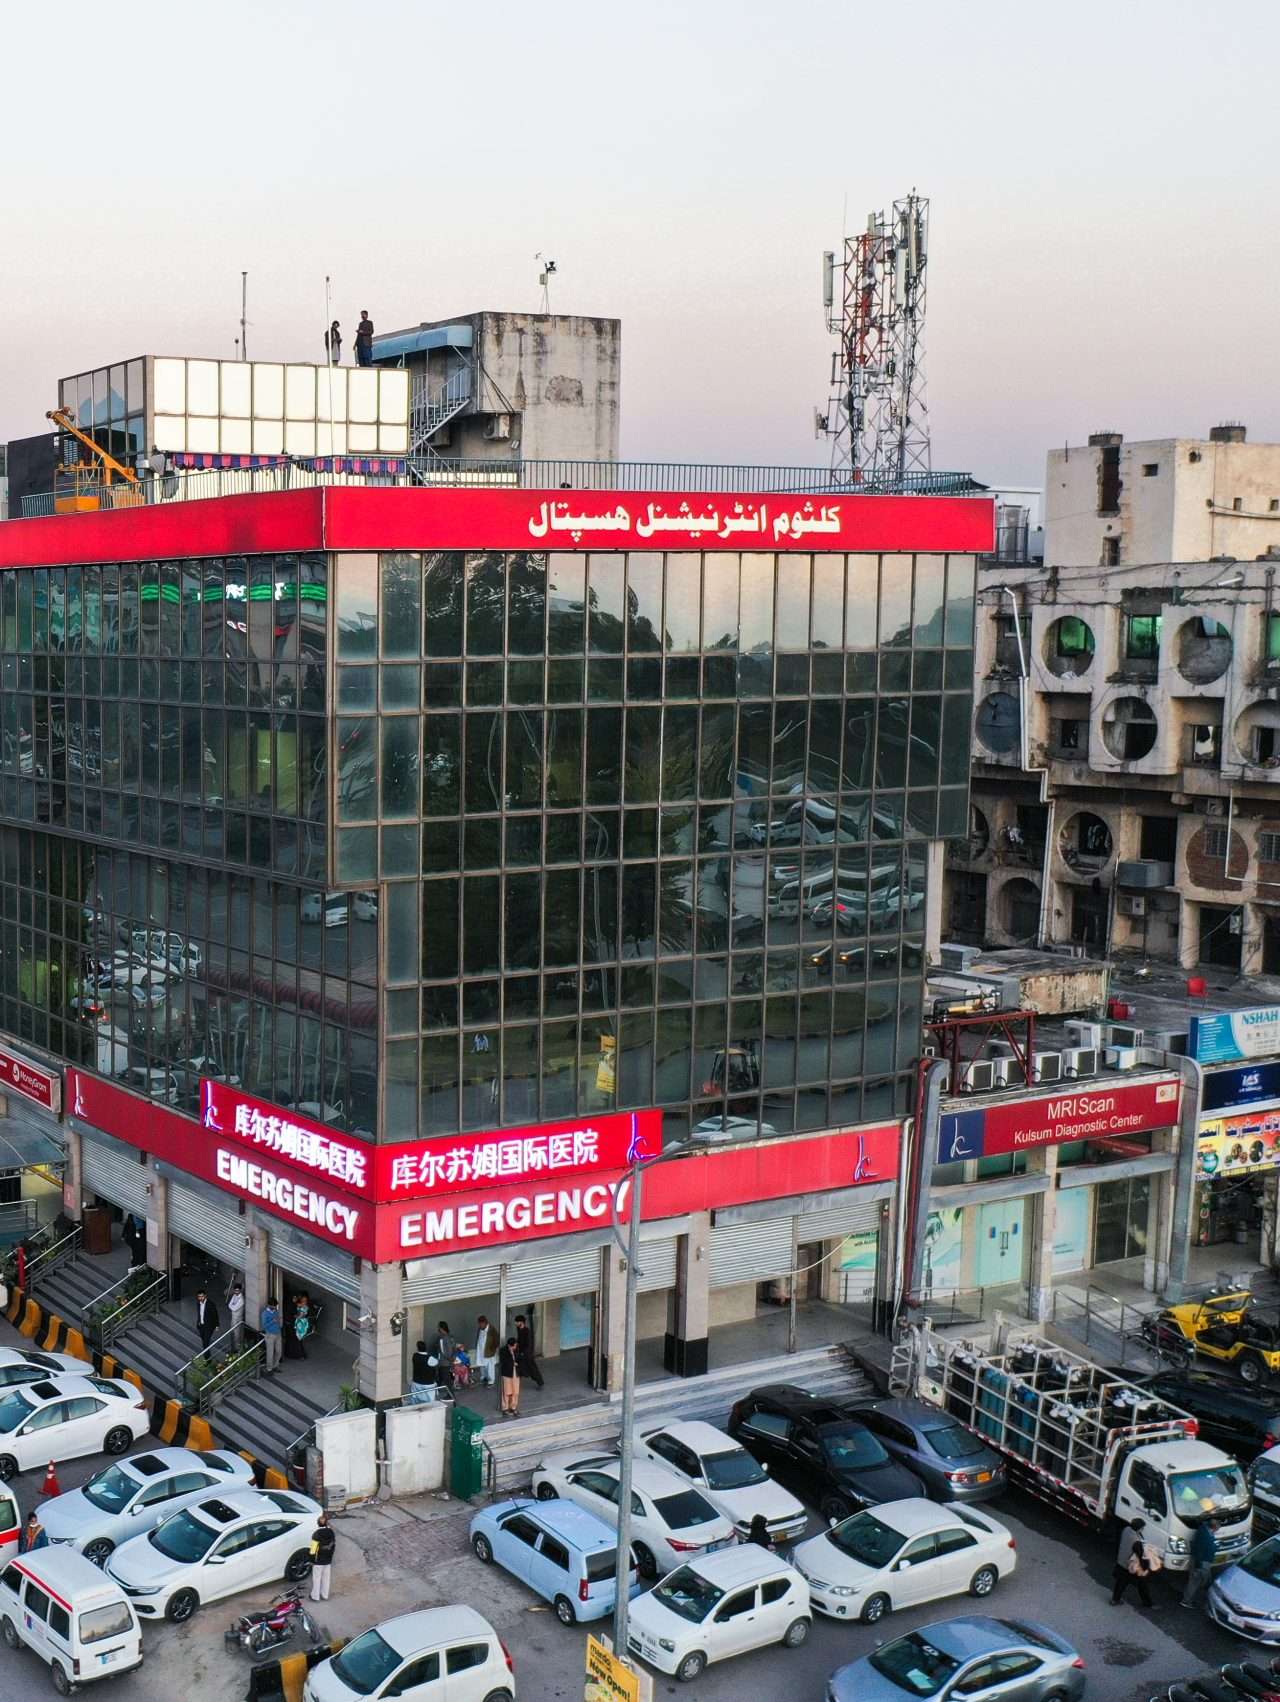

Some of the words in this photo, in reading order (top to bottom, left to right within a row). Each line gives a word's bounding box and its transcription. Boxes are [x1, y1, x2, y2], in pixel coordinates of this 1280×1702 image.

[772, 501, 841, 542] کلثوم
[234, 1103, 366, 1188] 库尔苏姆国际医院
[391, 1127, 599, 1191] 库尔苏姆国际医院
[1014, 1127, 1053, 1145] Kulsum
[1055, 1118, 1108, 1139] Diagnostic
[1109, 1112, 1144, 1130] Center
[216, 1148, 360, 1242] EMERGENCY
[399, 1180, 631, 1248] EMERGENCY
[589, 1657, 607, 1681] Now
[606, 1673, 631, 1702] Open!
